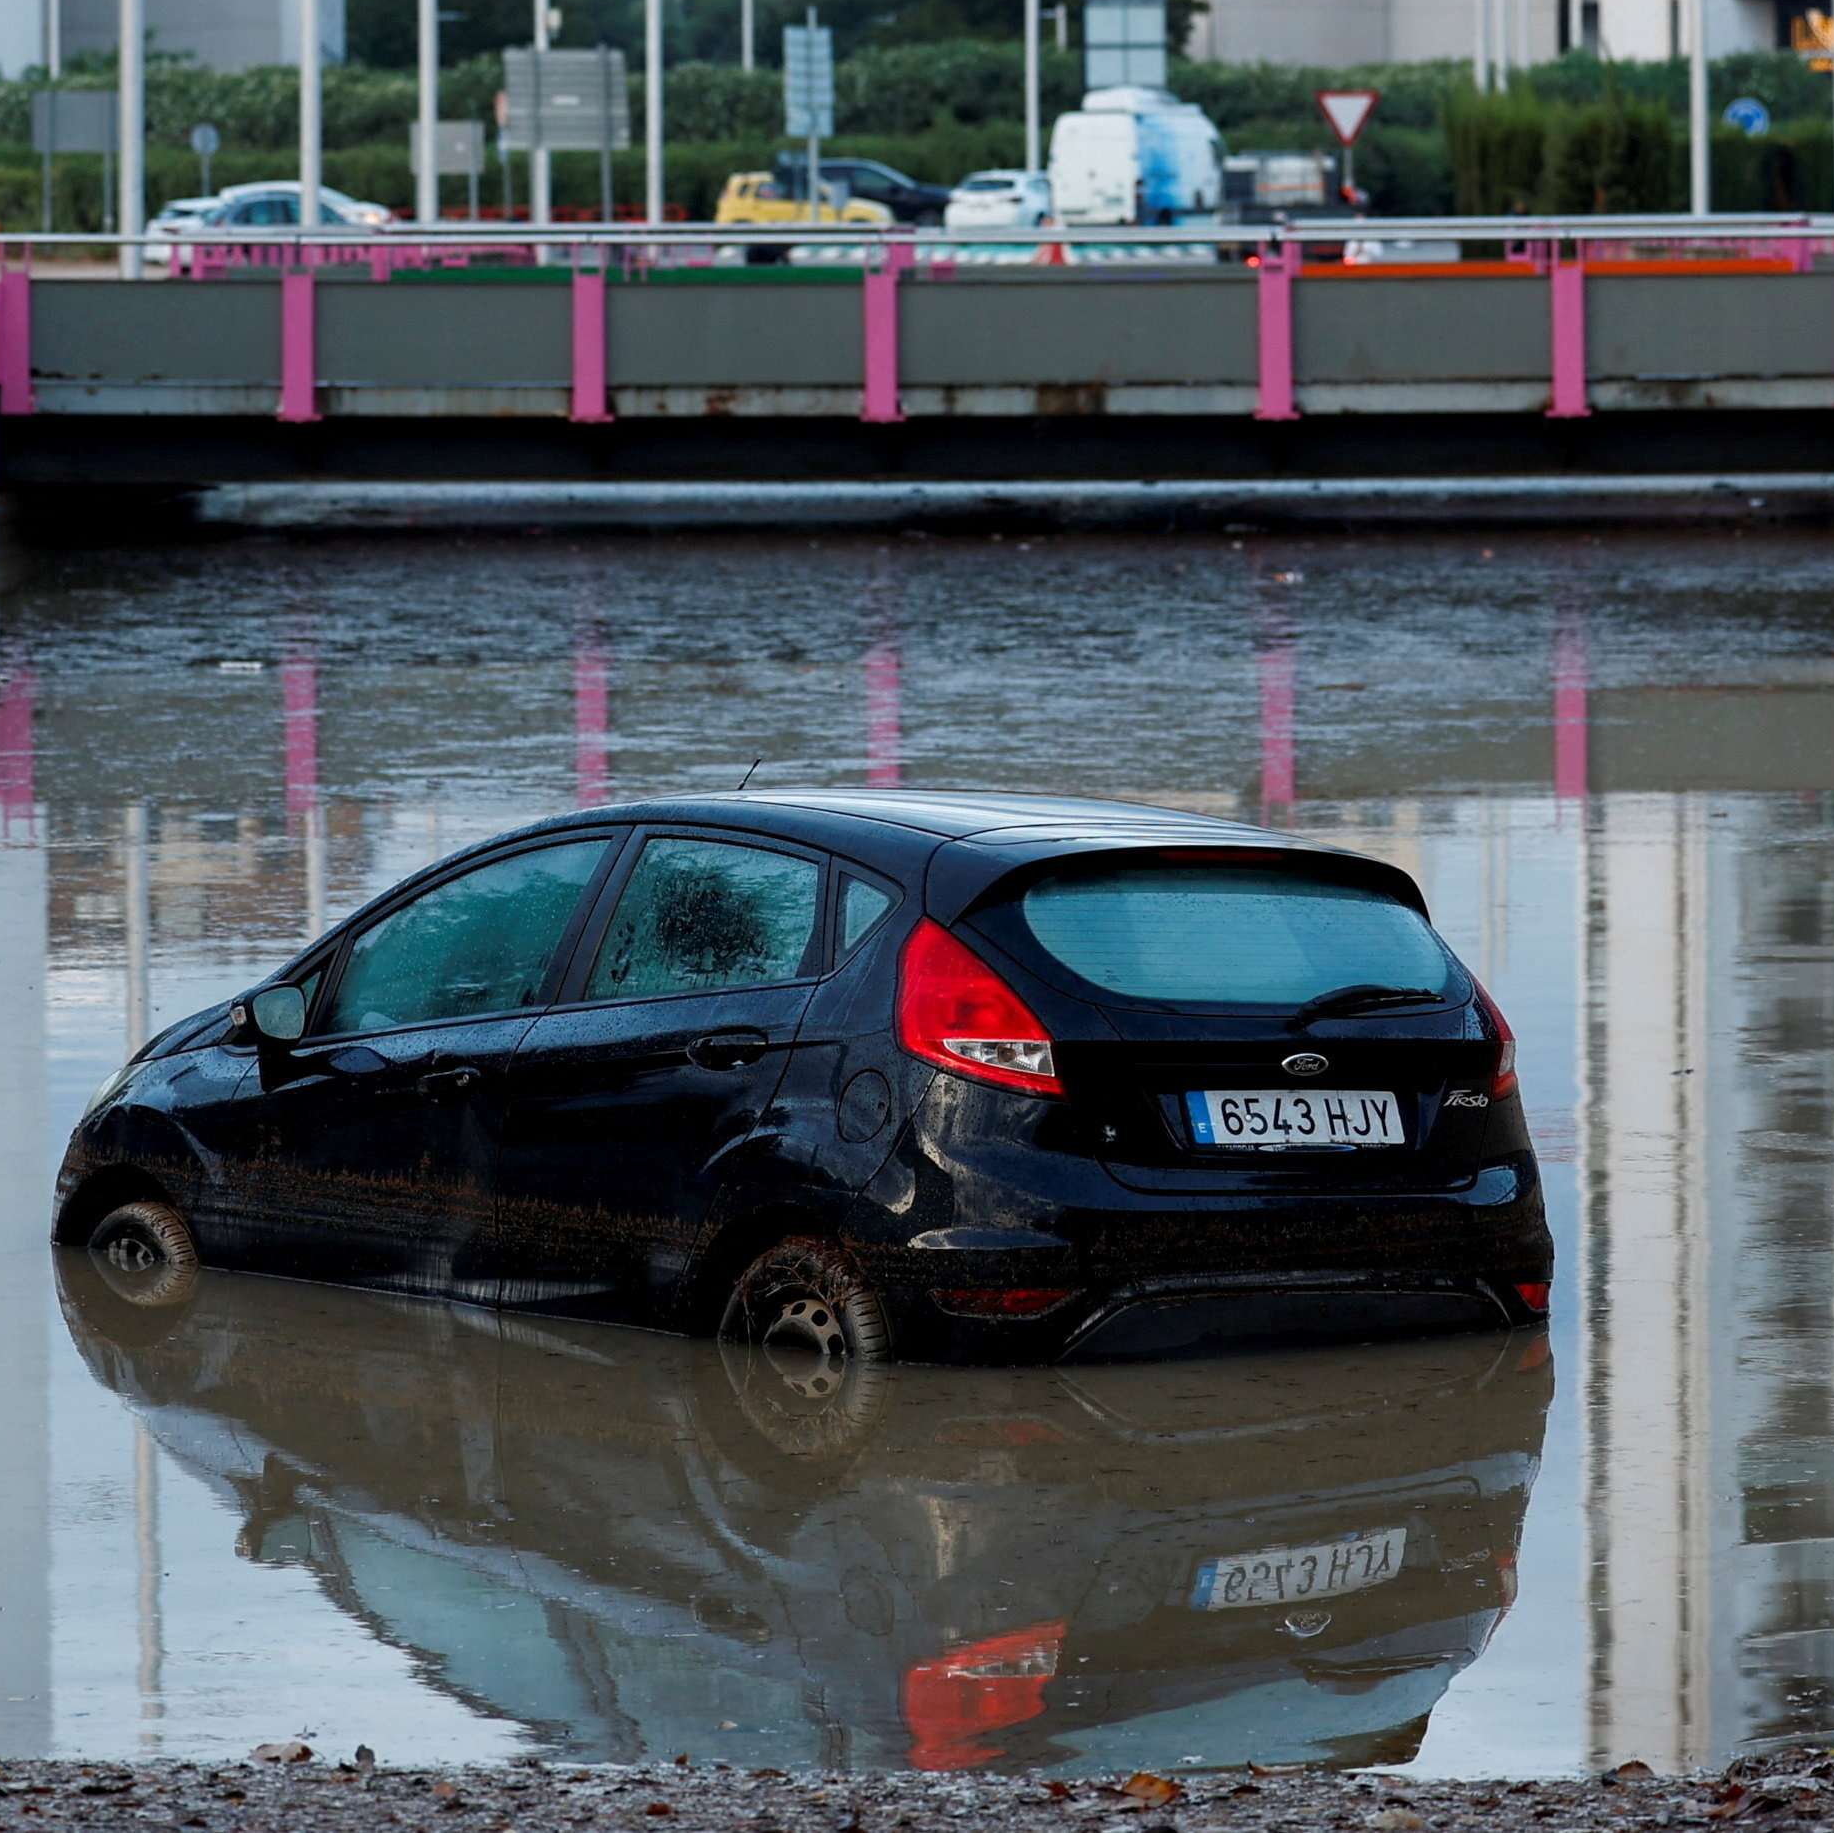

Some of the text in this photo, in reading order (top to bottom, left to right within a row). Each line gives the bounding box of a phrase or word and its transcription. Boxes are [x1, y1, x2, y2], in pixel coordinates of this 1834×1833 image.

[1294, 1058, 1319, 1071] Ford
[1443, 1089, 1489, 1108] Fiesta
[1197, 1097, 1388, 1137] E 6543 HJY
